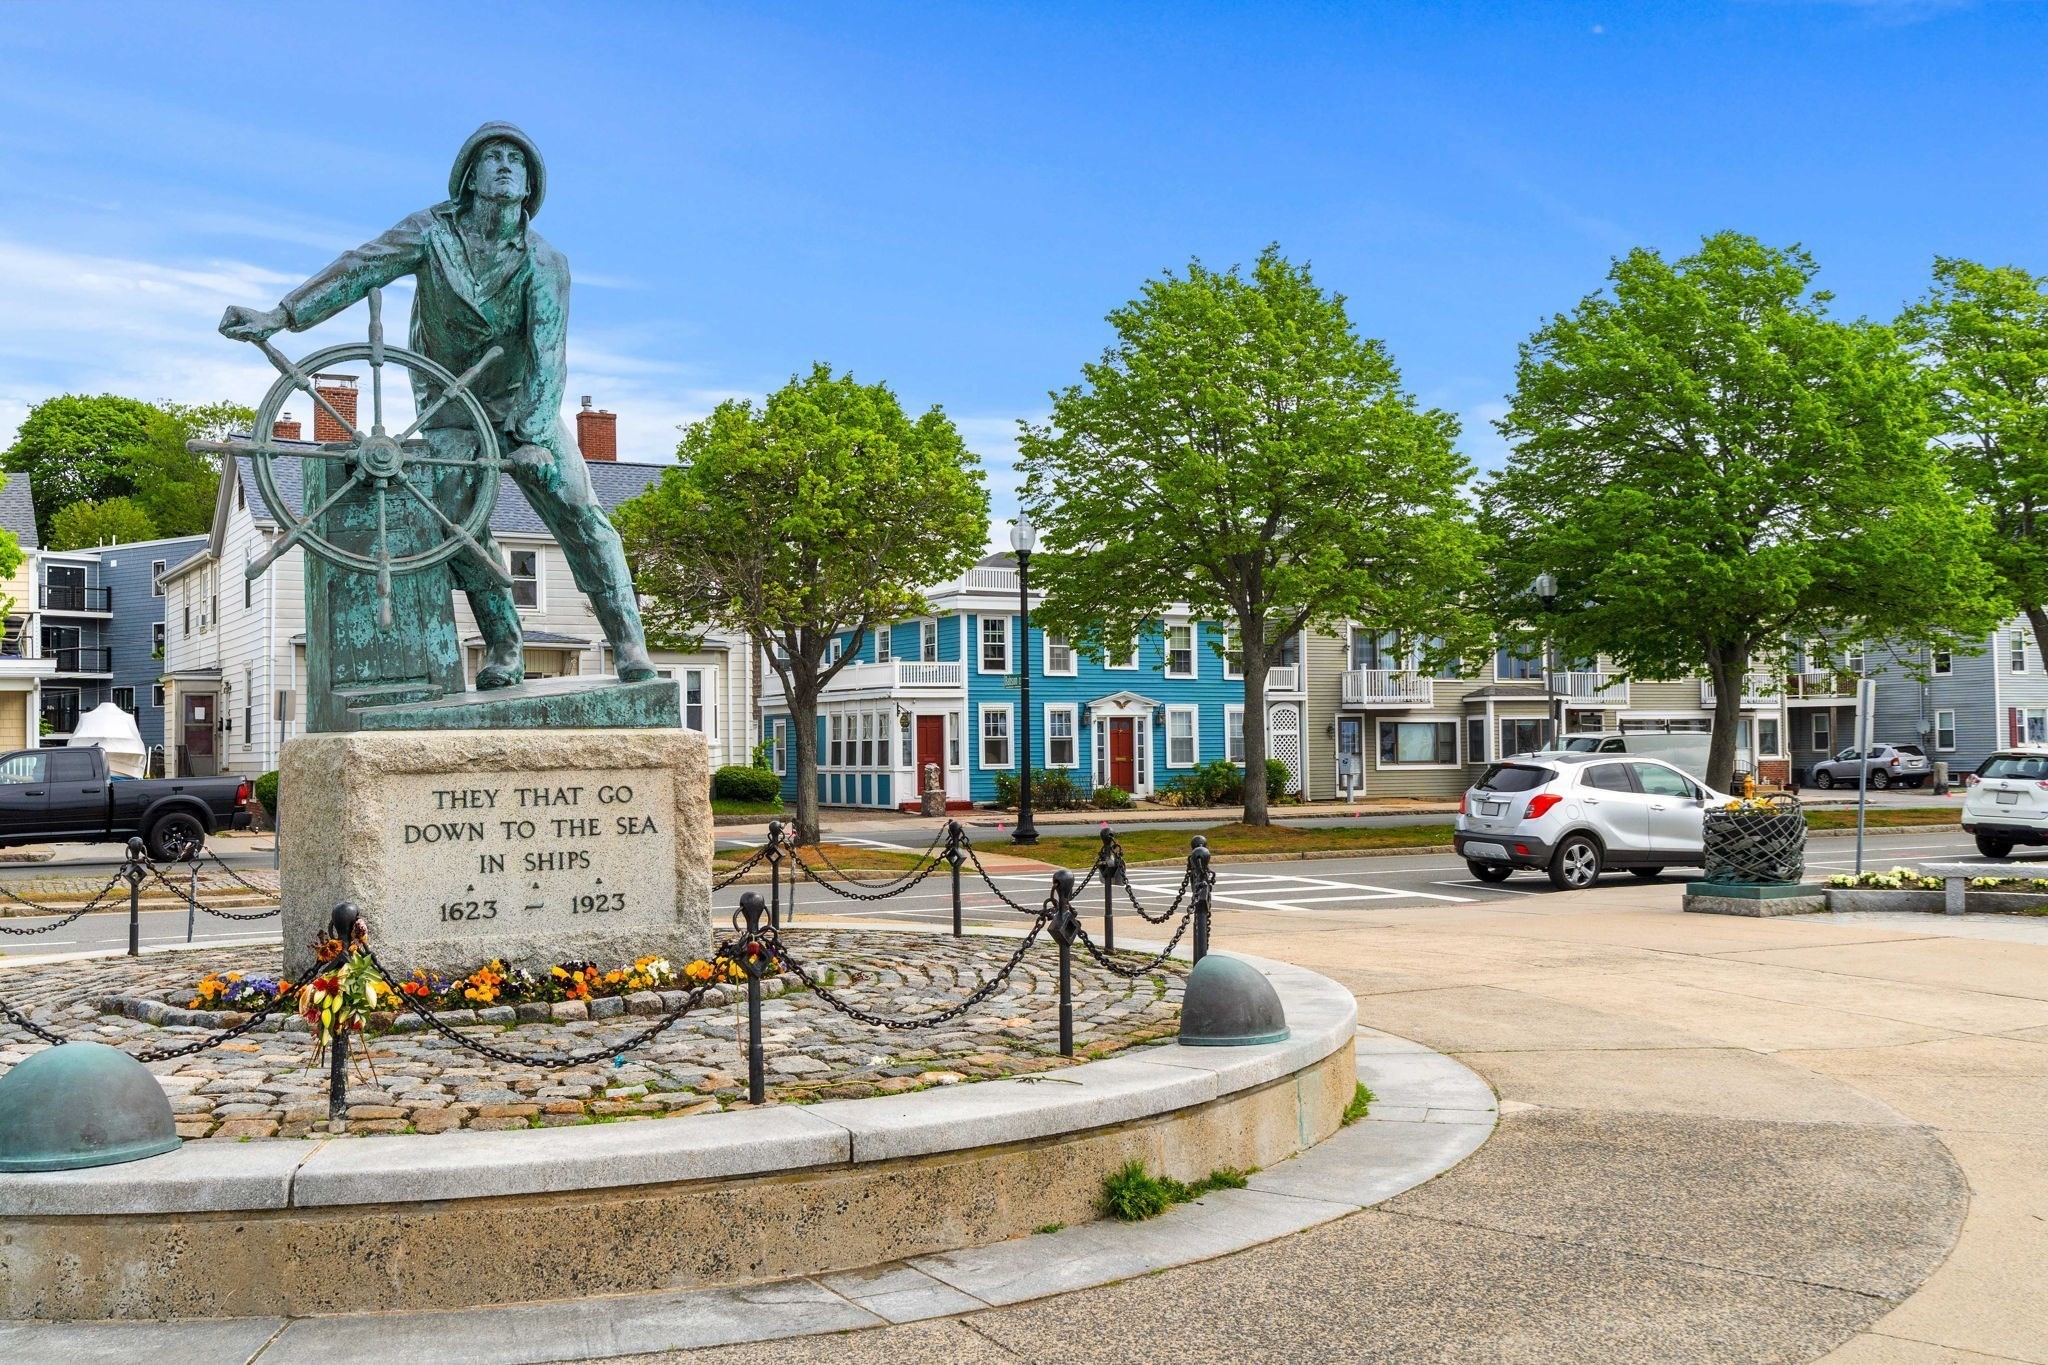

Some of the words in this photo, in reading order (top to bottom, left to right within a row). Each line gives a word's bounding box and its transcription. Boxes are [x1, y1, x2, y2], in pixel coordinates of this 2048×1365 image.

[432, 789, 499, 809] THEY
[514, 787, 584, 807] THAT
[597, 785, 633, 804] GO
[405, 823, 484, 843] DOWN
[499, 821, 536, 840] TO
[550, 818, 602, 838] THE
[616, 815, 659, 835] SEA
[480, 854, 506, 874] IN
[524, 850, 591, 872] SHIPS
[440, 900, 498, 922] 1623
[572, 892, 626, 915] 1923
